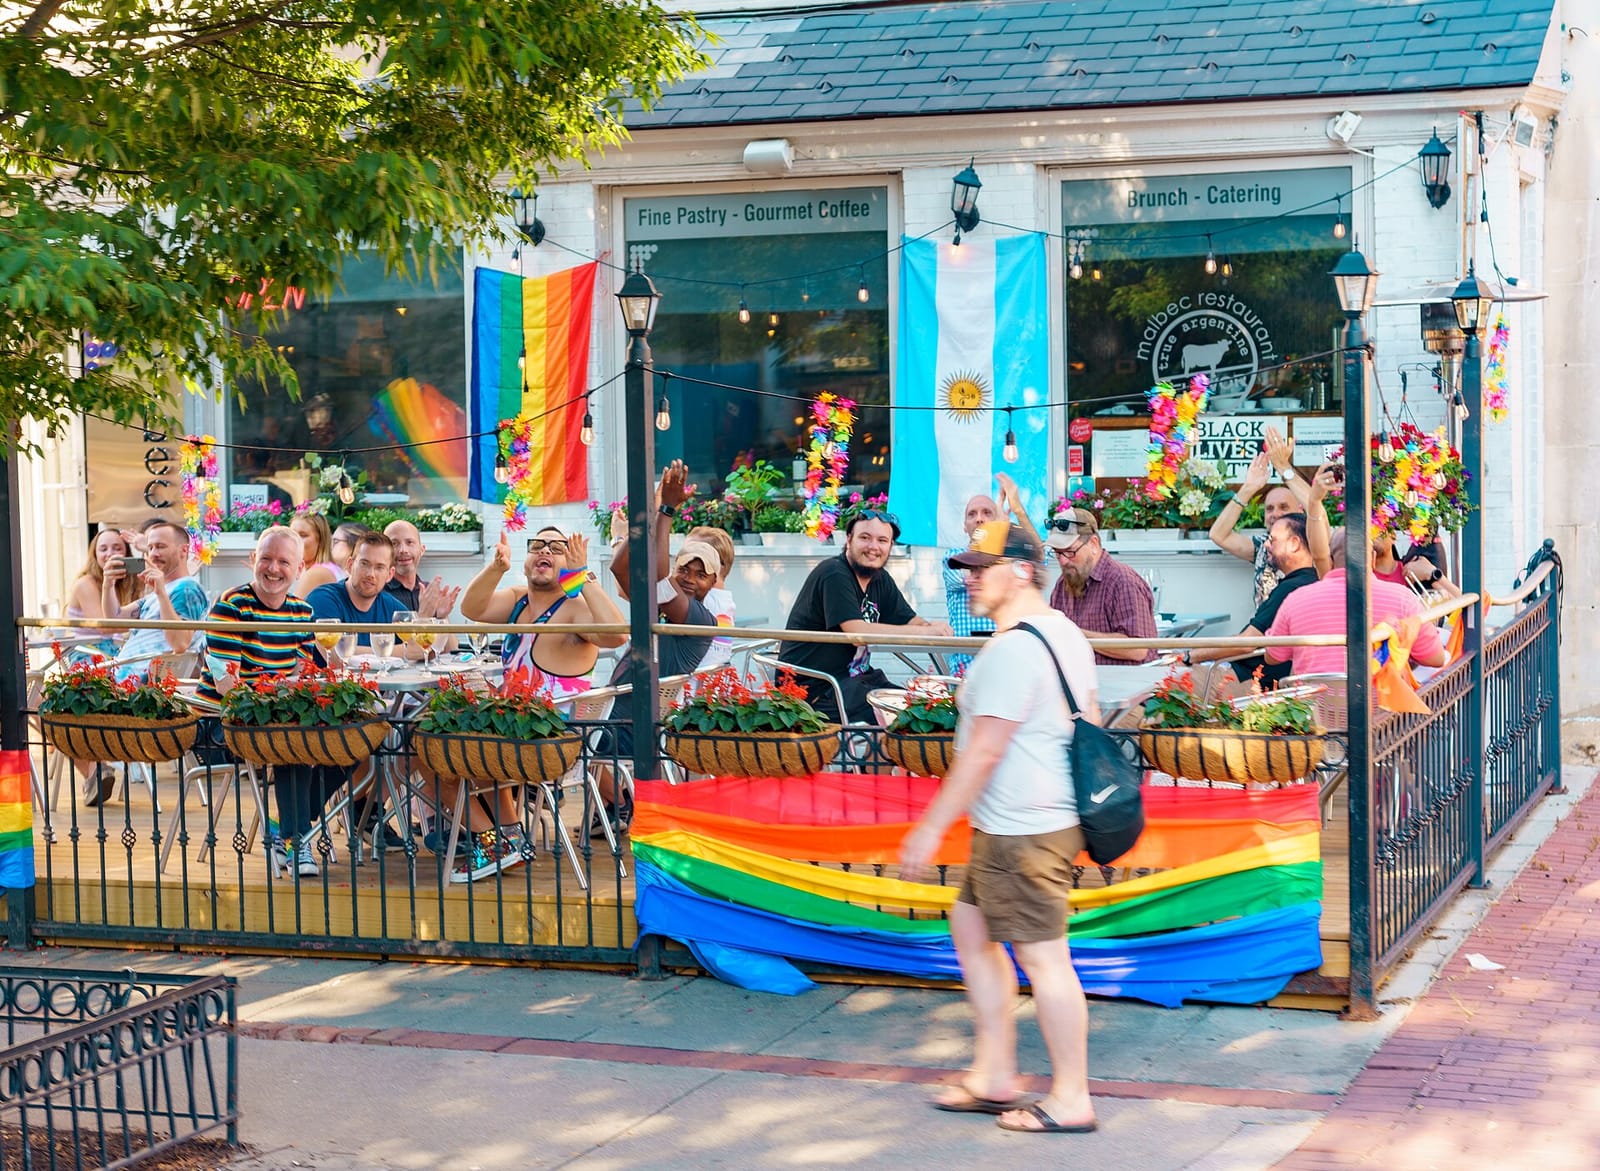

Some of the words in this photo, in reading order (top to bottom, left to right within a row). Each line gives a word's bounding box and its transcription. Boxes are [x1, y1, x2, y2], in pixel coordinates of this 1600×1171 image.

[1127, 187, 1188, 208] Brunch
[1207, 184, 1281, 205] Catering
[638, 208, 671, 226] Fine
[677, 206, 727, 227] Pastry
[744, 201, 813, 222] Gourmet
[818, 199, 870, 219] Coffee
[1137, 296, 1192, 361] malbec
[1198, 292, 1278, 361] restaurant
[1158, 334, 1178, 370] true
[1181, 317, 1249, 357] argentine
[1197, 421, 1265, 437] BLACK
[1194, 440, 1258, 459] LIVES
